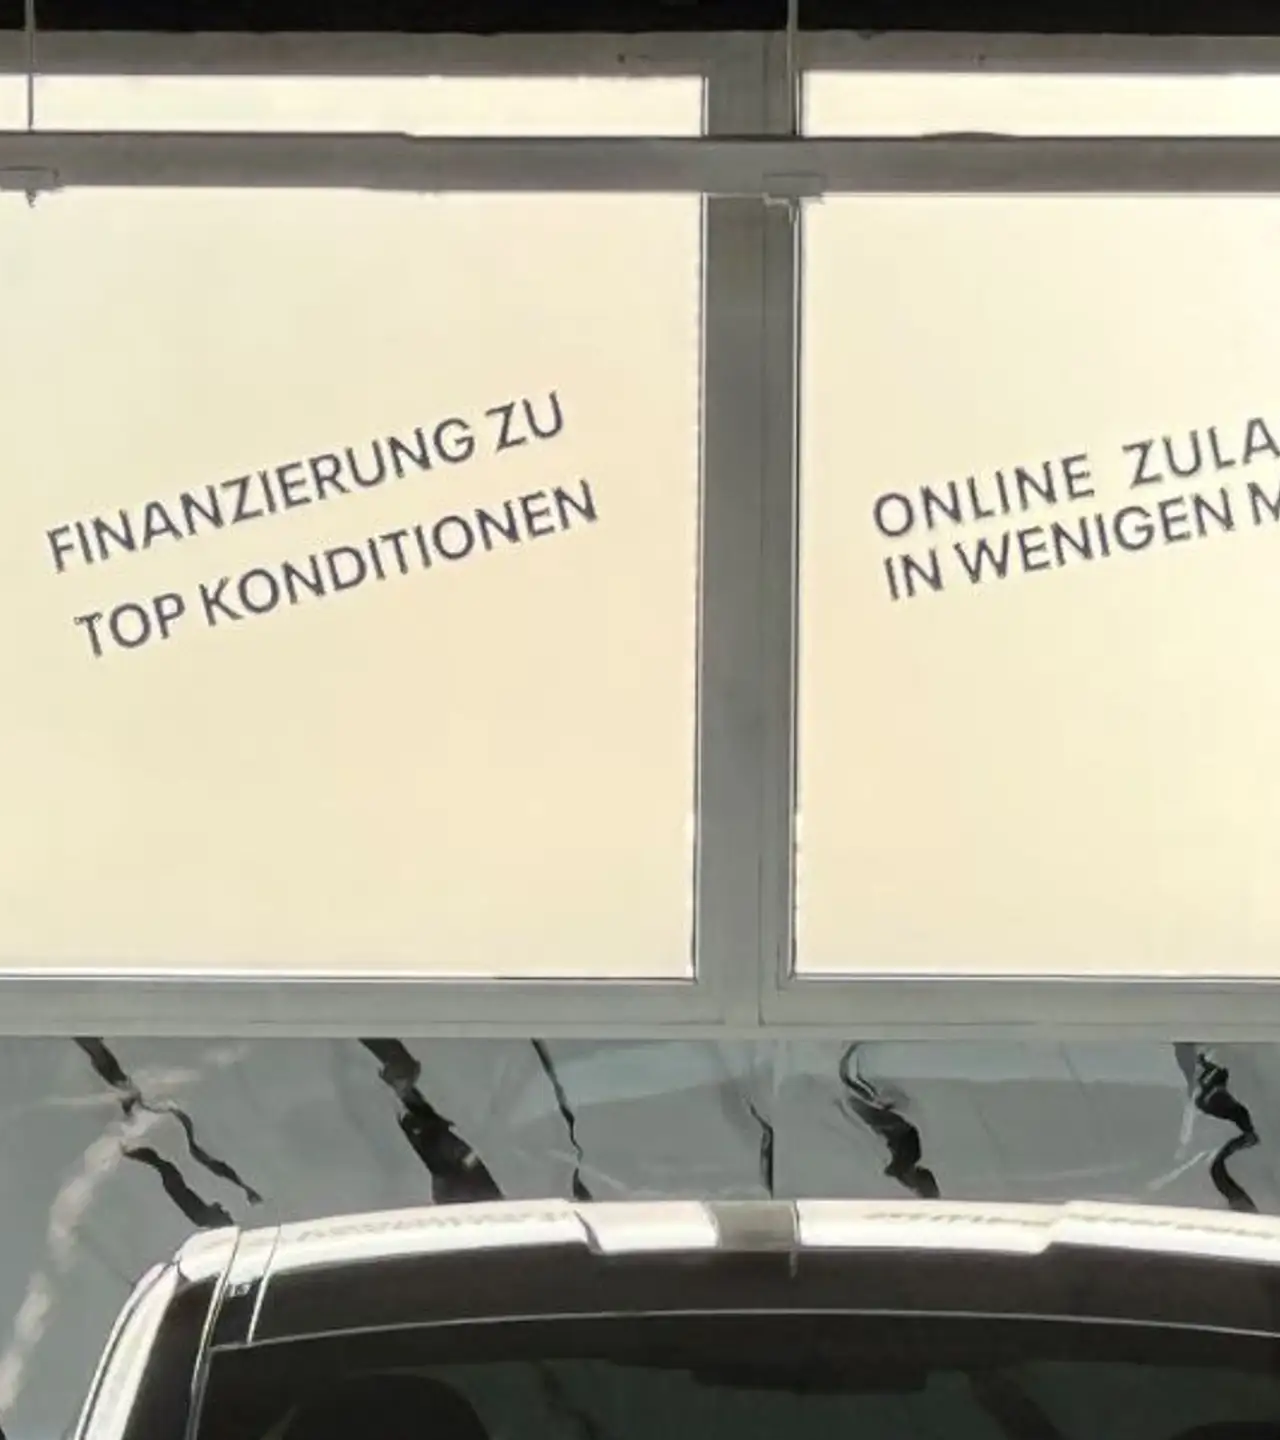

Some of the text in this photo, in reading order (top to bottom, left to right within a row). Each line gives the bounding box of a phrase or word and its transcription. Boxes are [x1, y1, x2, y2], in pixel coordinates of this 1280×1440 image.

[47, 391, 563, 573] FINANZIERUNG ZU
[873, 454, 1094, 537] ONLINE
[884, 549, 943, 600] IN
[954, 488, 1234, 584] WENIGEN
[74, 480, 597, 657] TOP KONDITIONEN
